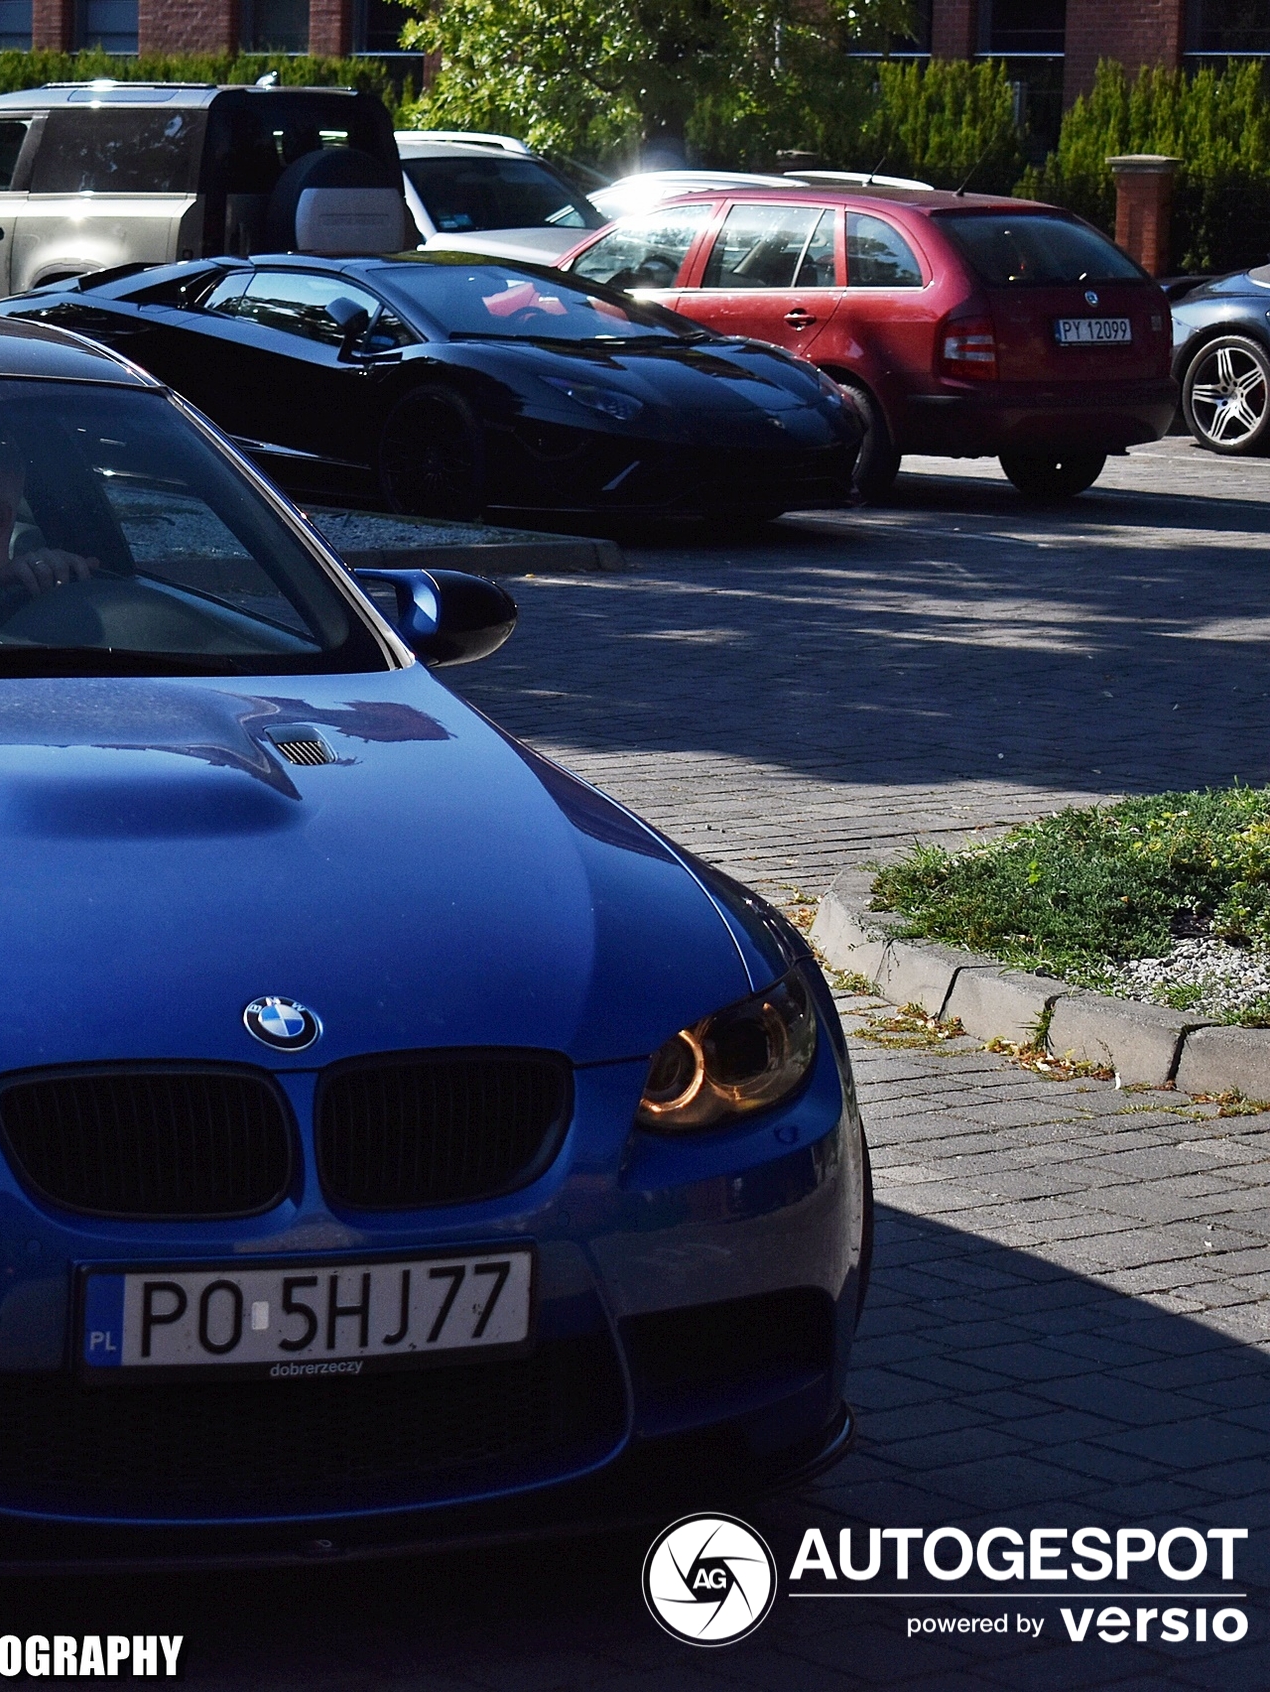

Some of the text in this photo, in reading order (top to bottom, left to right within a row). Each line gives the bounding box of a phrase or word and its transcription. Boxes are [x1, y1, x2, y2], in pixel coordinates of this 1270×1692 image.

[1062, 320, 1128, 340] PY 12099
[140, 1261, 512, 1358] PO 5HJ77
[90, 1331, 117, 1352] PL
[270, 1358, 364, 1377] dobrerzeczy
